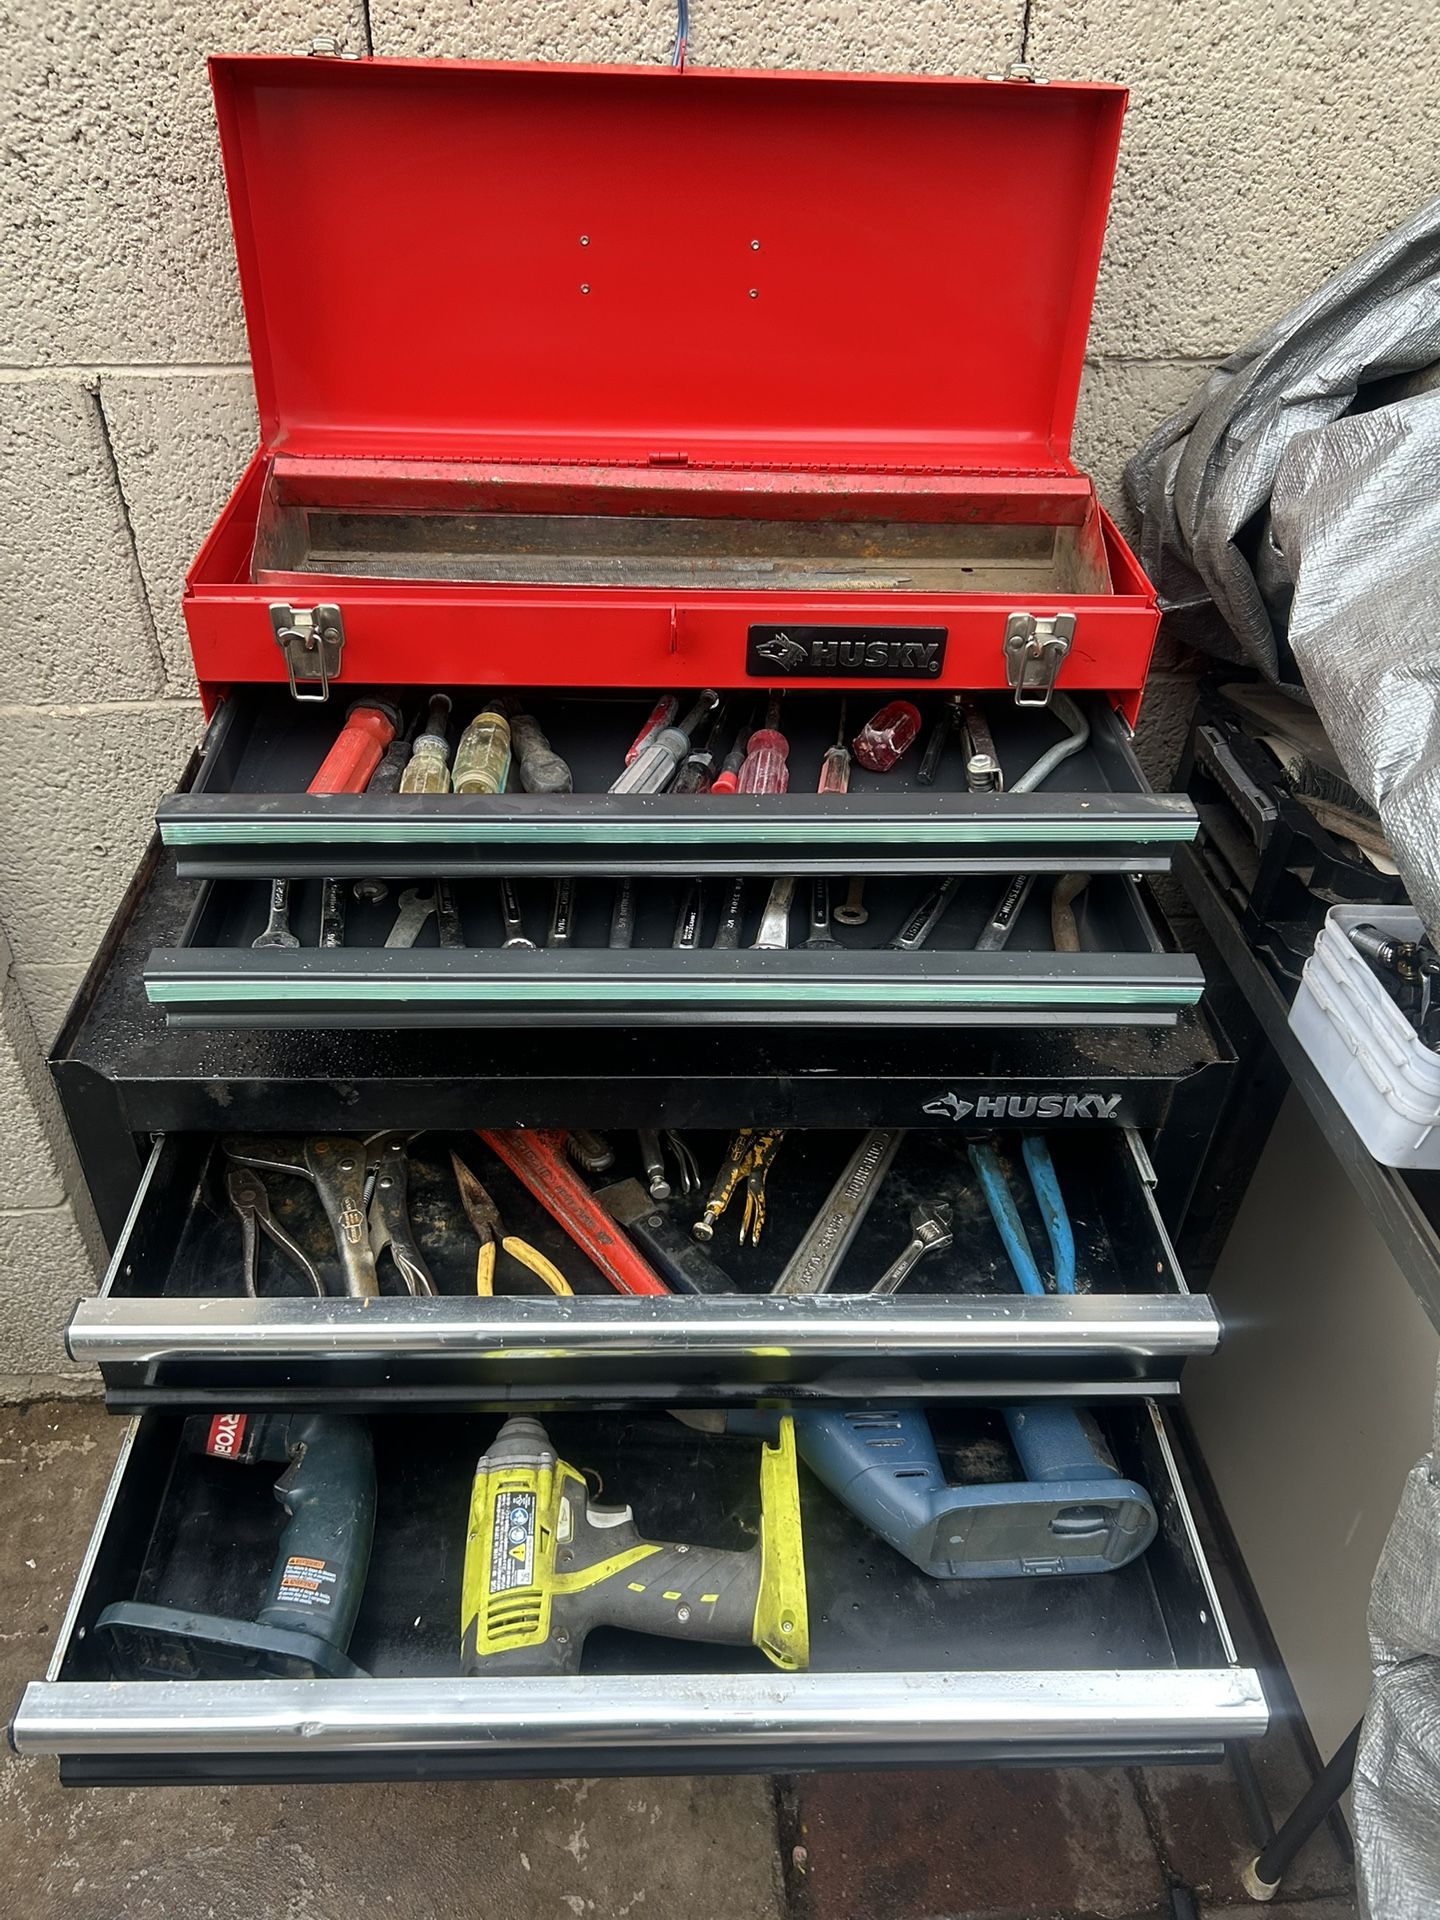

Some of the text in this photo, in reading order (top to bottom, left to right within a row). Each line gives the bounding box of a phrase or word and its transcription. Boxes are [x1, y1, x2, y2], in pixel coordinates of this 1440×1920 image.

[811, 641, 939, 668] HUSKY
[975, 1094, 1122, 1118] HUSKY
[214, 1414, 240, 1457] RYOBI
